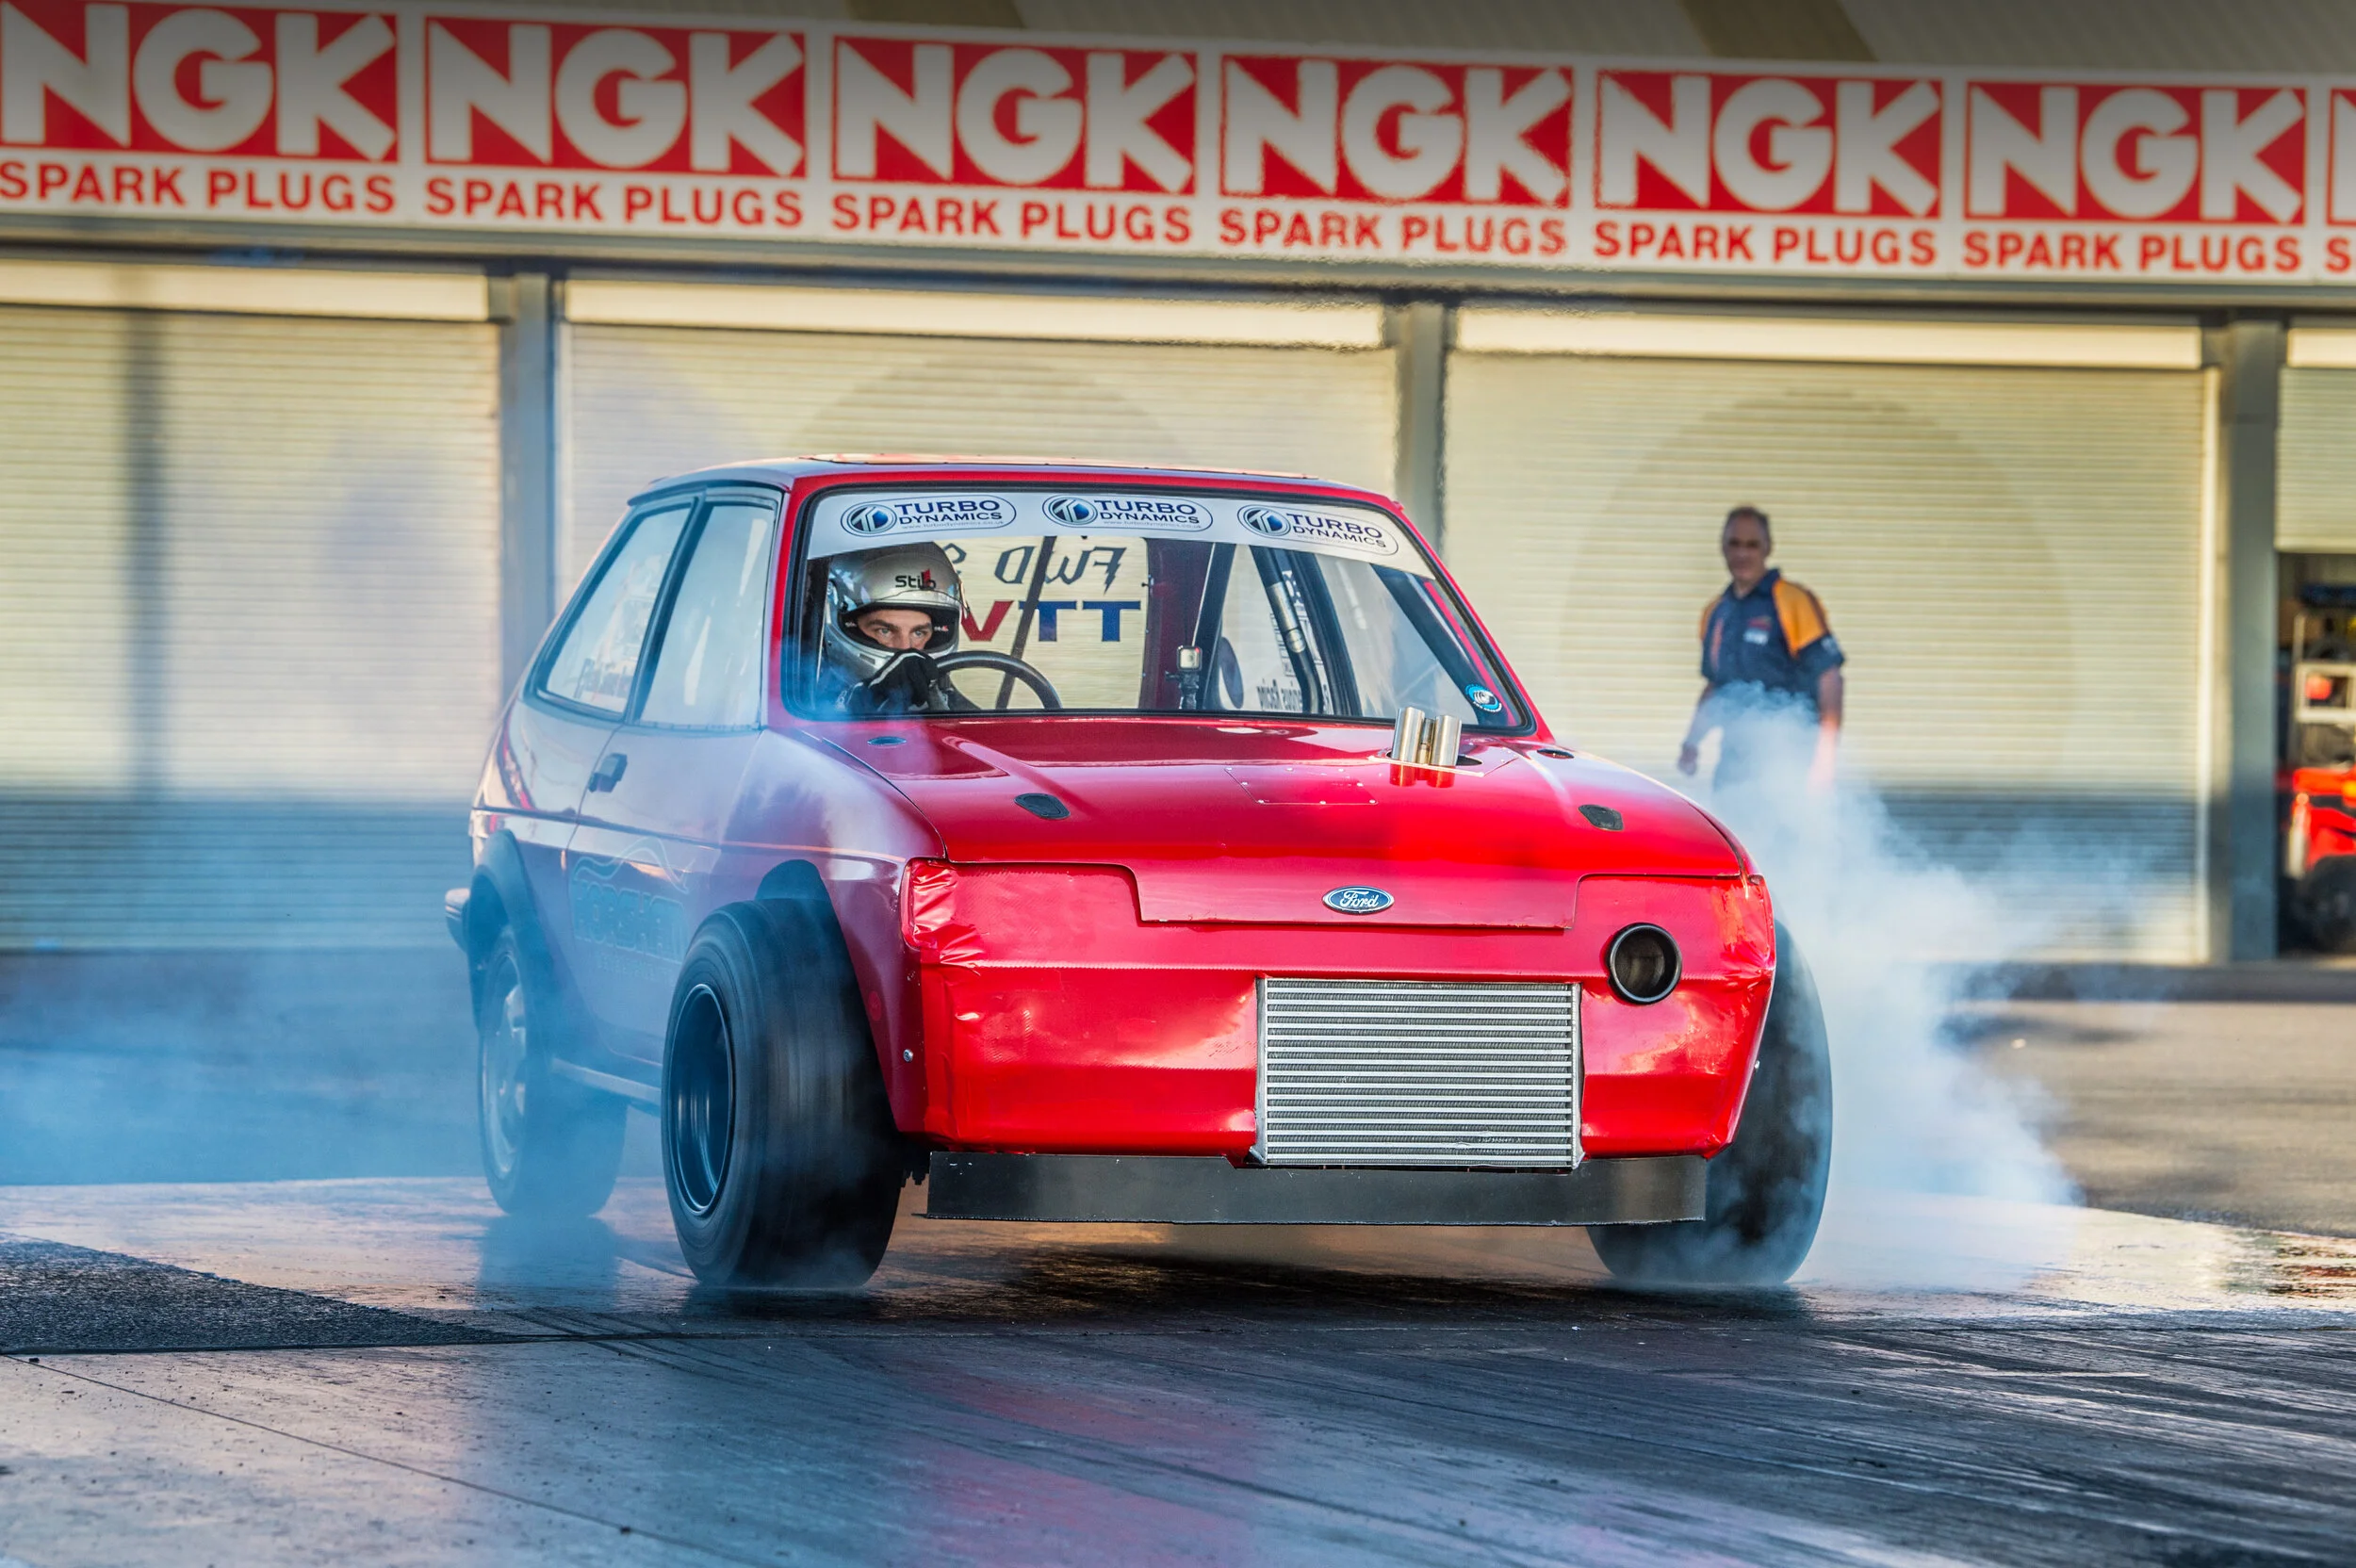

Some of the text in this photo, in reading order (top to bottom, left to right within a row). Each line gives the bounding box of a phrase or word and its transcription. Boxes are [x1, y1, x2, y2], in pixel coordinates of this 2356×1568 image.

[1, 1, 398, 161] NGK
[428, 23, 806, 177] NGK
[836, 42, 1195, 193] NGK
[1224, 58, 1572, 205] NGK
[1599, 75, 1940, 218] NGK
[1968, 87, 2304, 224] NGK
[0, 161, 396, 214] SPARK PLUGS
[426, 177, 804, 228] SPARK PLUGS
[831, 193, 1192, 245] SPARK PLUGS
[1219, 208, 1567, 256] SPARK PLUGS
[1594, 220, 1938, 267] SPARK PLUGS
[1963, 230, 2121, 270] SPARK
[2138, 234, 2301, 273] PLUGS
[894, 500, 1000, 515] TURBO
[900, 512, 1003, 525] DYNAMICS
[1094, 499, 1196, 514] TURBO
[1100, 512, 1200, 524] DYNAMICS
[1286, 513, 1383, 539] TURBO
[1293, 525, 1387, 548] DYNAMICS
[895, 568, 937, 590] Stilo
[1339, 890, 1380, 907] Ford
